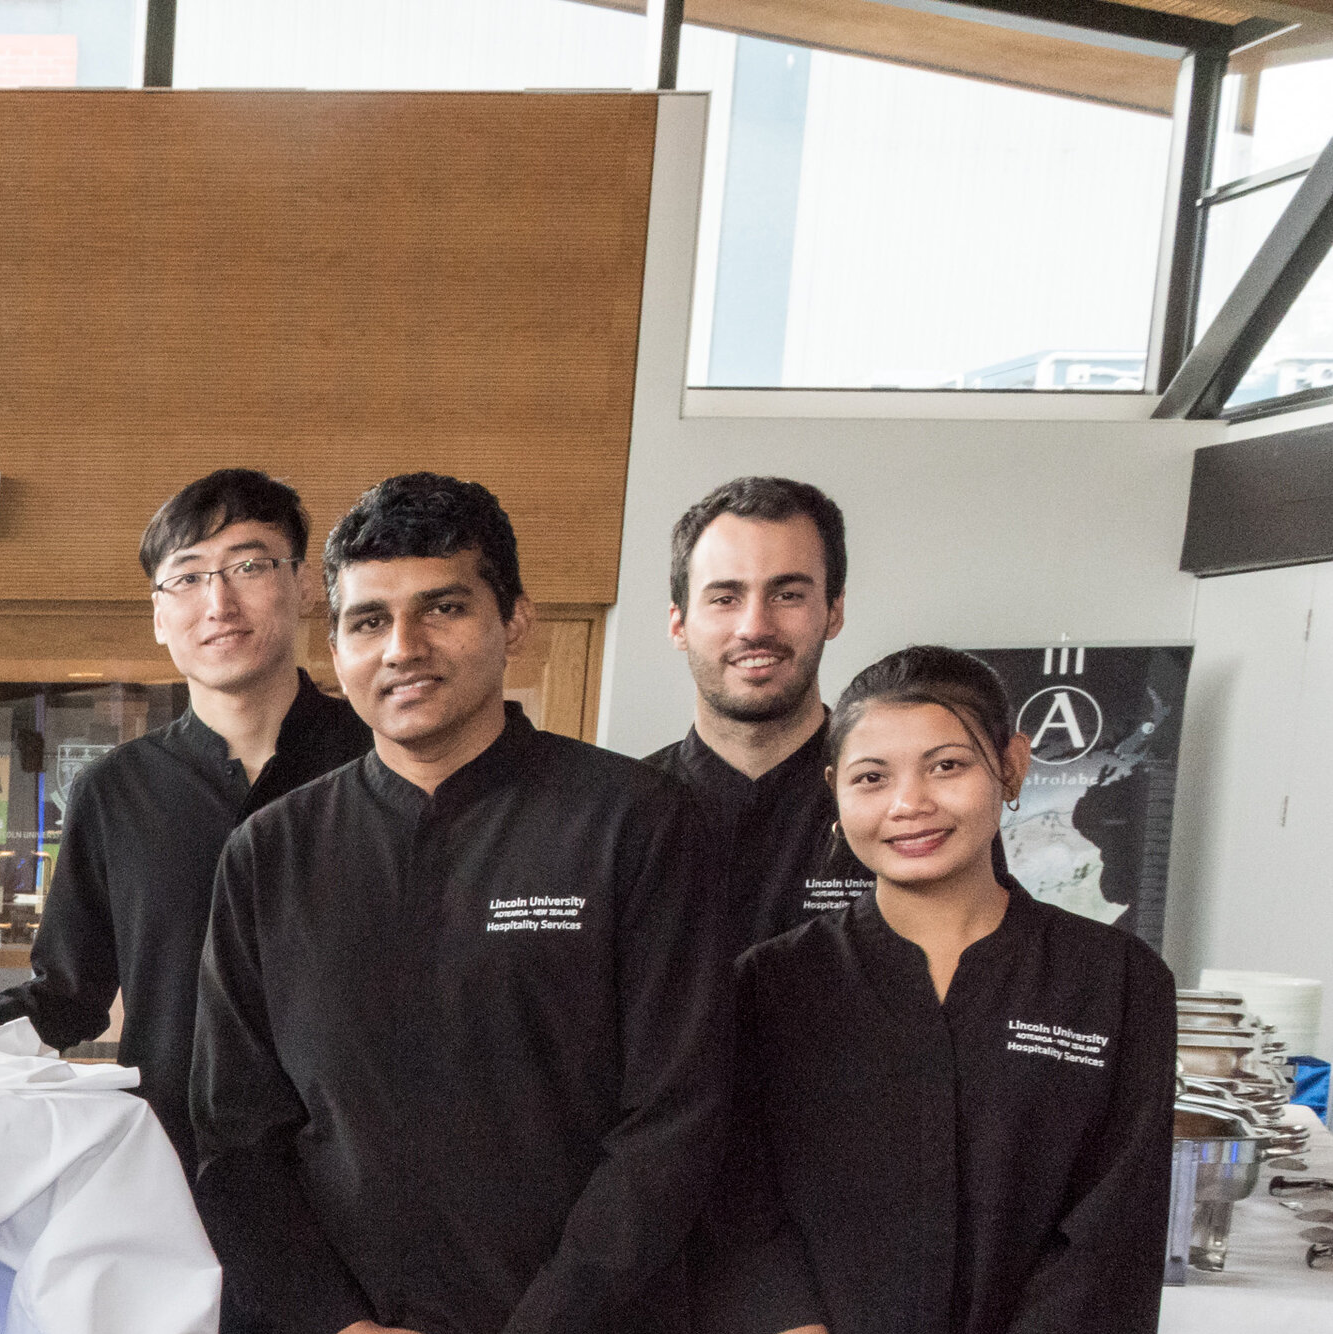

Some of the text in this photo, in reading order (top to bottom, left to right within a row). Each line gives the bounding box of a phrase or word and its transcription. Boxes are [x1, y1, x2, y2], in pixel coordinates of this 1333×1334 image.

[1030, 692, 1086, 749] A
[1025, 773, 1098, 785] strolabe
[805, 879, 874, 888] Lincoln Unive
[490, 896, 586, 909] Lincoln University
[486, 919, 582, 932] Hospitality Services
[1009, 1020, 1109, 1047] Lincoln University
[1007, 1041, 1105, 1067] Hospitality Services
